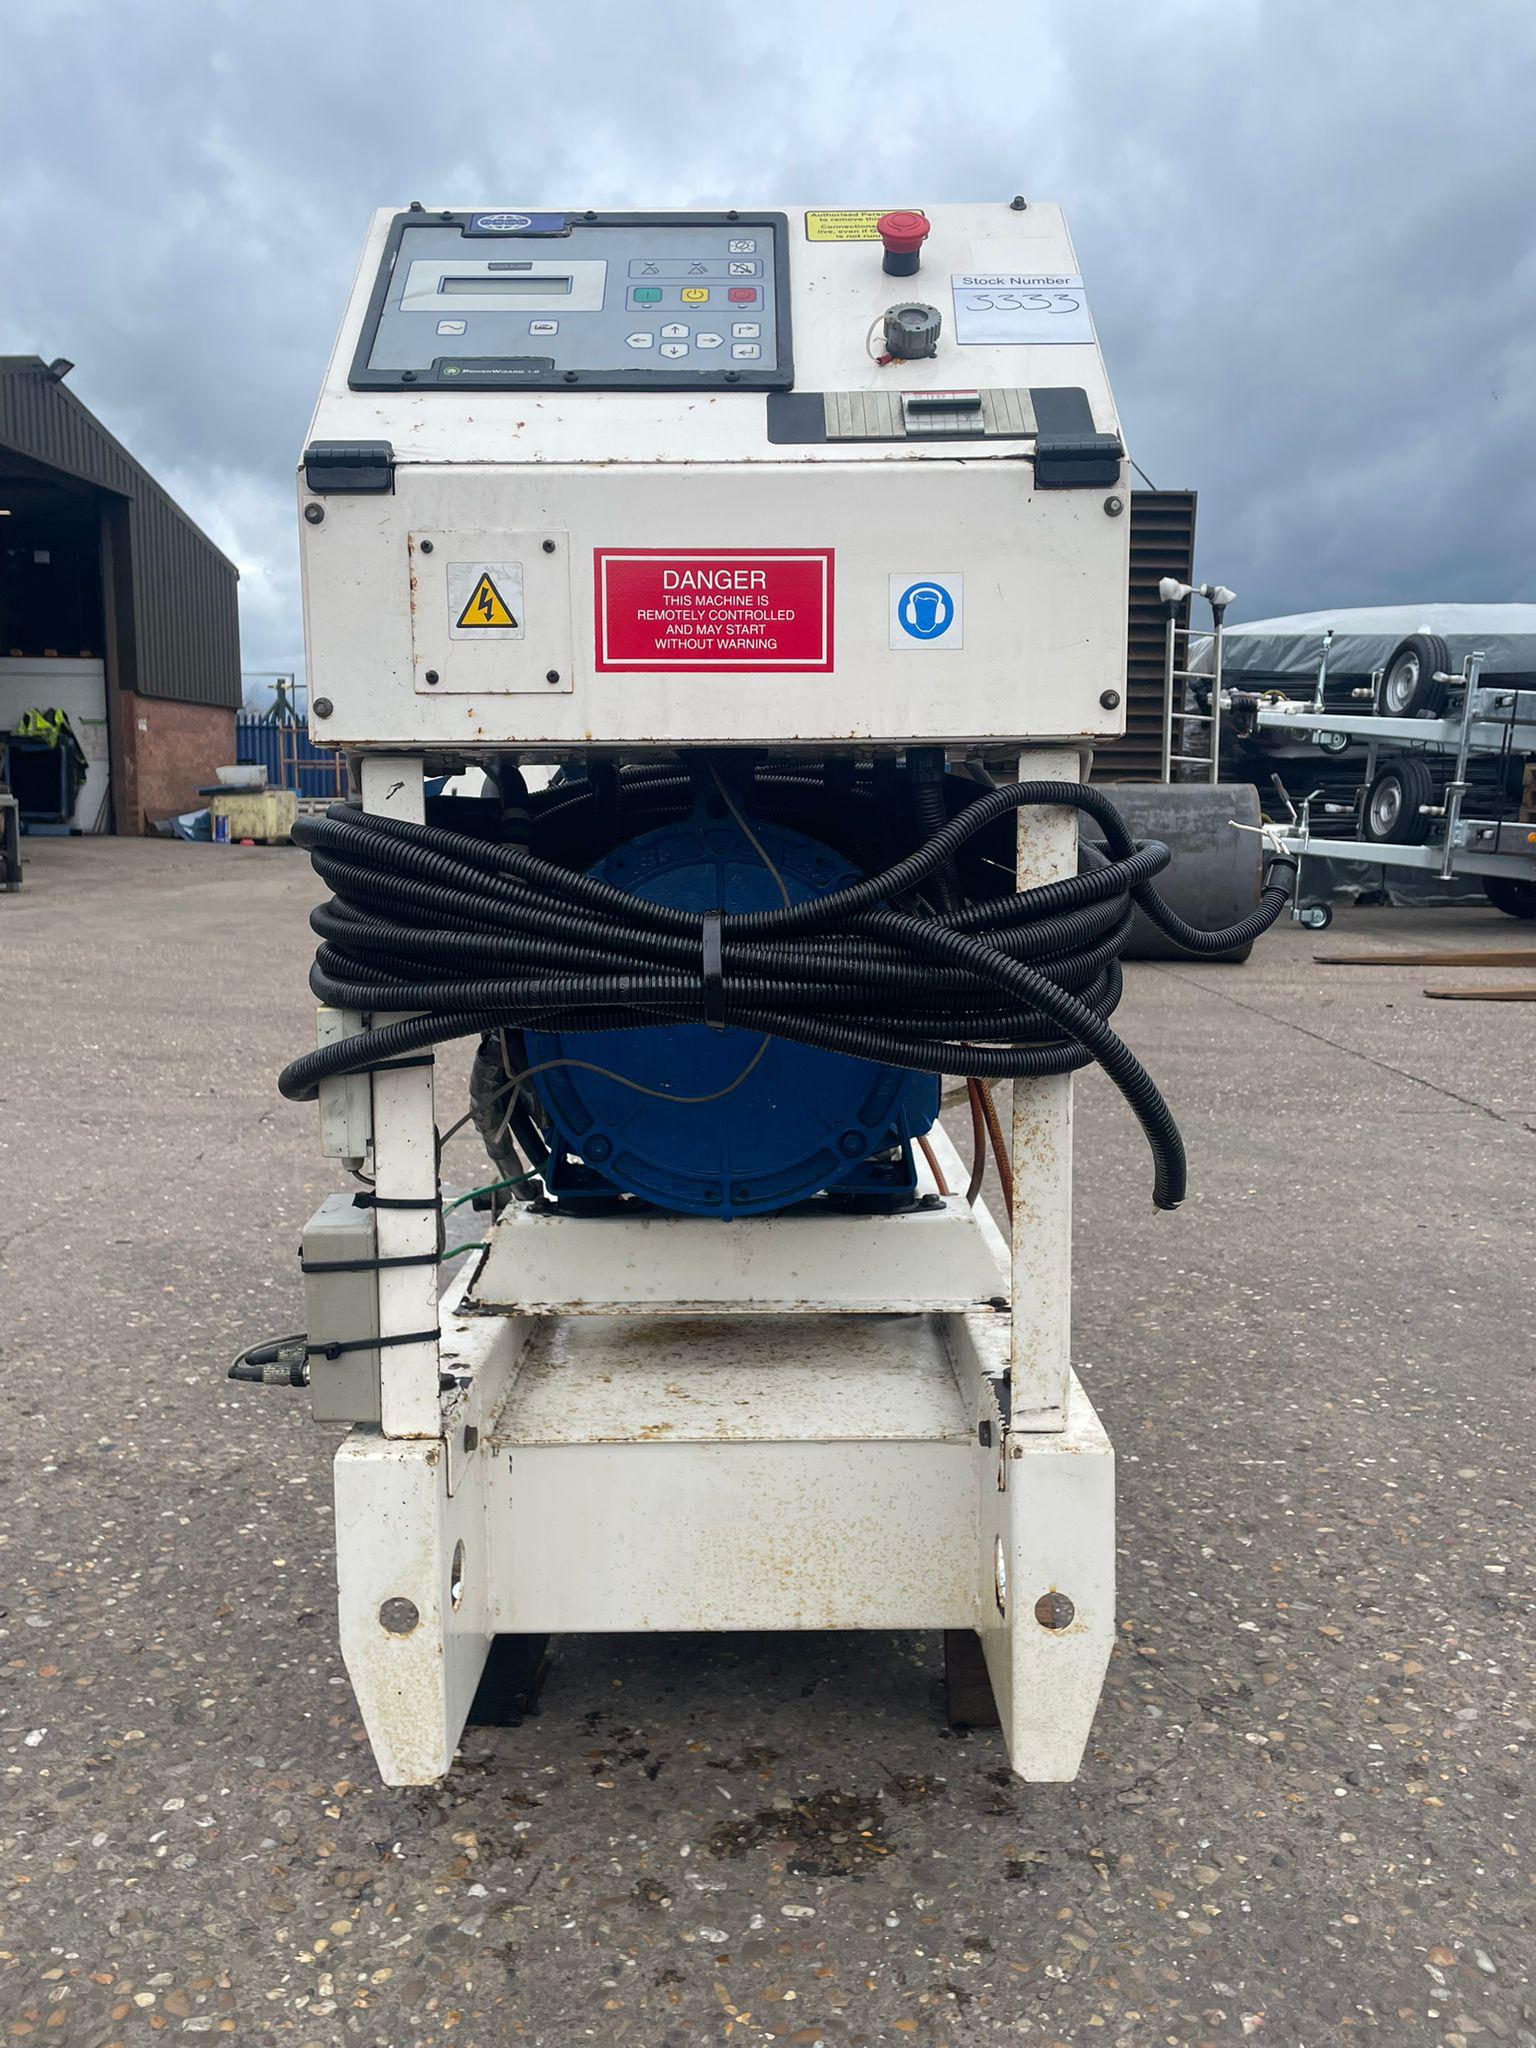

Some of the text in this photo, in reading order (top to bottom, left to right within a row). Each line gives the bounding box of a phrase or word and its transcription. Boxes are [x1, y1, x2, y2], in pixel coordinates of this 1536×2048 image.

[963, 277, 1071, 285] Stock Number
[966, 294, 1080, 314] 3333
[663, 570, 767, 590] DANGER
[663, 595, 769, 606] THIS MACHINE IS
[637, 609, 795, 621] REMOTELY CONTROLLED
[666, 624, 767, 635] AND MAY START
[654, 638, 778, 650] WITHOUT WARNING
